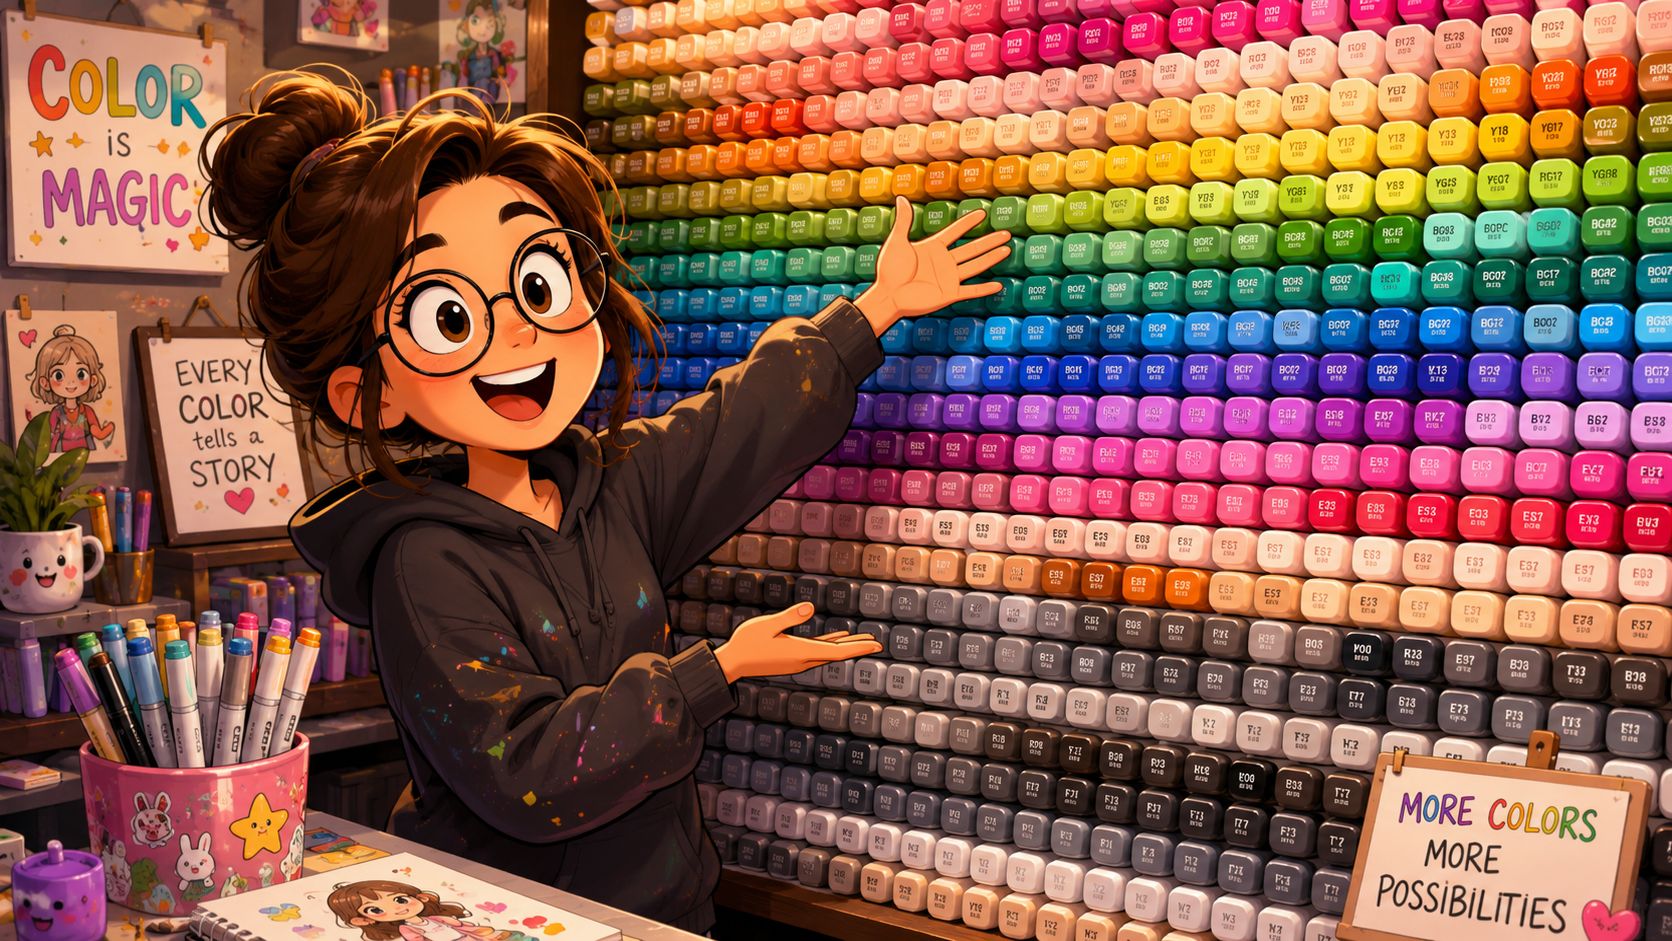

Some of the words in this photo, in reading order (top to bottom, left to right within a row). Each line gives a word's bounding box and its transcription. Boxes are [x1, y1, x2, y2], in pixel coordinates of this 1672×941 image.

[27, 44, 207, 130] COLOR
[107, 128, 131, 158] is
[42, 166, 192, 230] MAGIC
[174, 358, 253, 388] EVERY
[179, 391, 270, 423] COLOR
[193, 424, 238, 449] tells
[248, 428, 264, 445] a
[190, 452, 276, 488] STORY
[1398, 792, 1475, 826] MORE
[1488, 798, 1598, 842] COLORS
[1424, 839, 1502, 874] MORE
